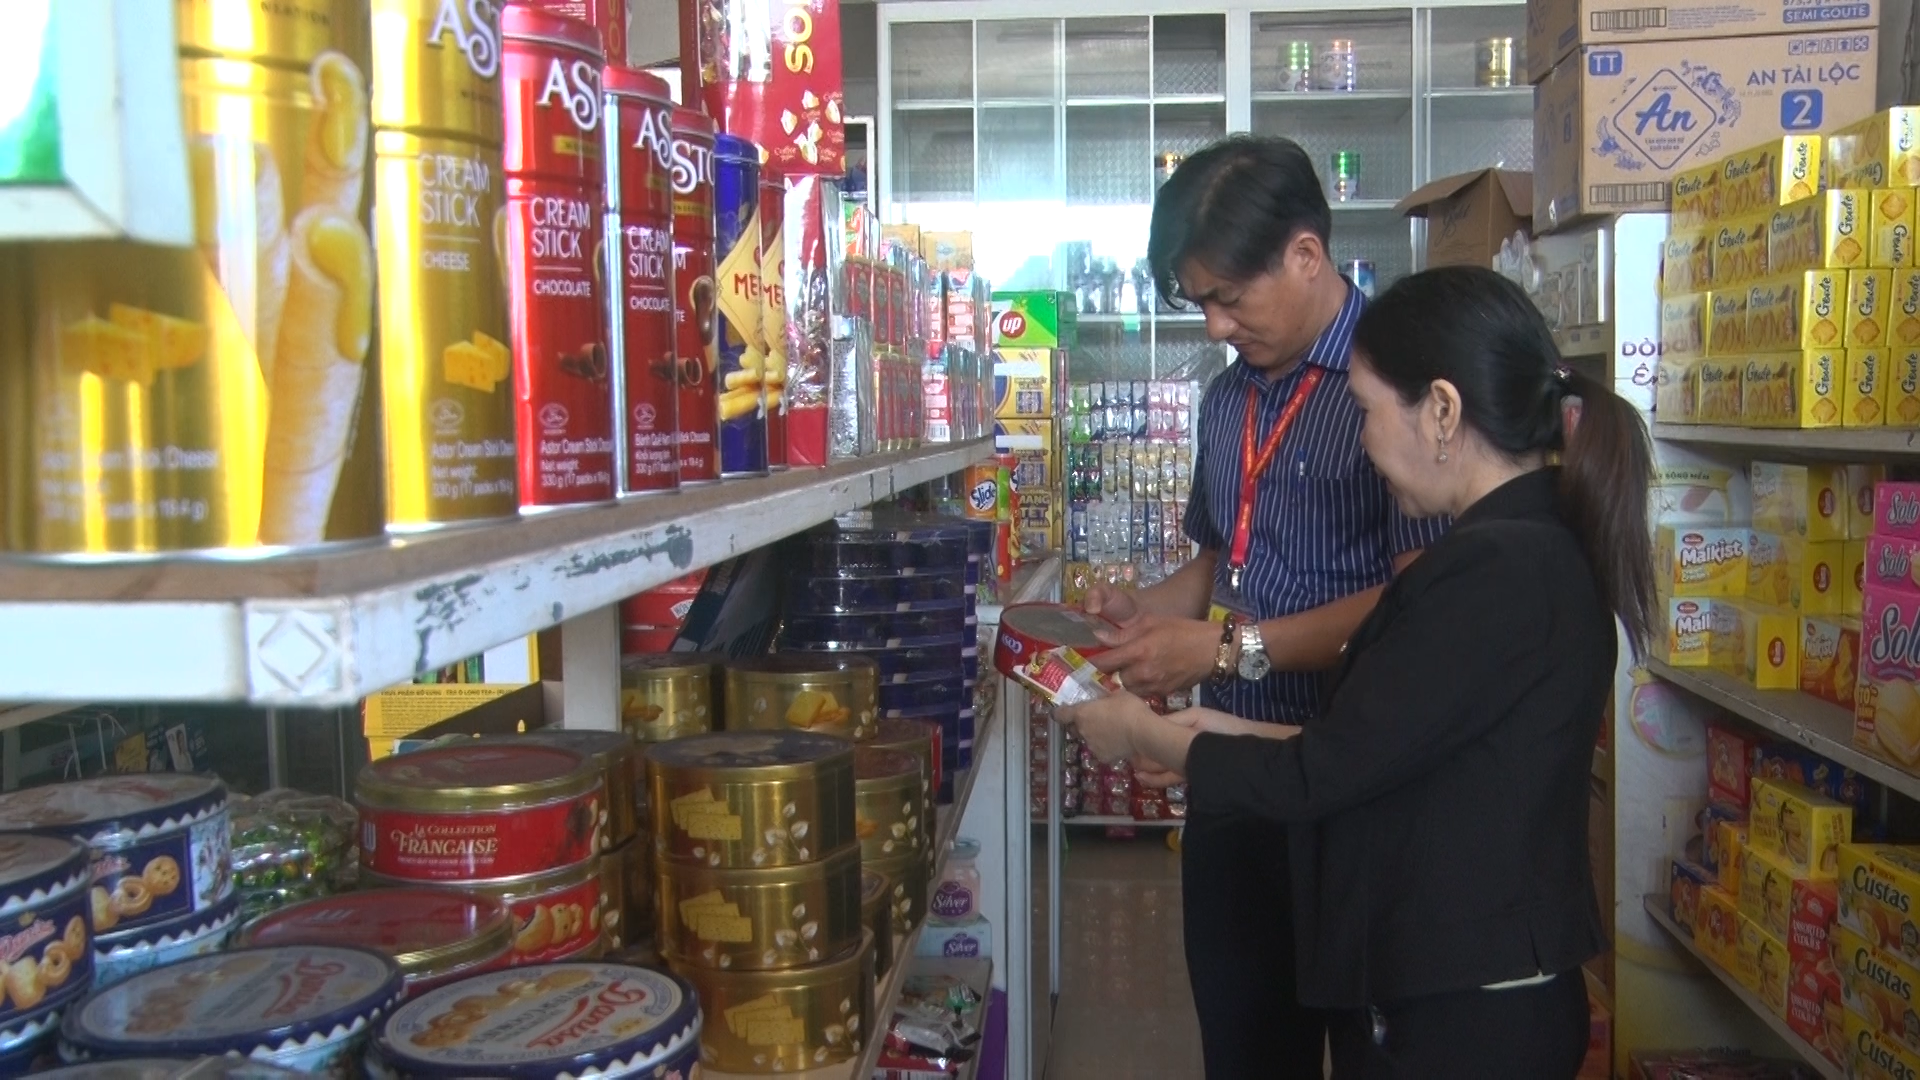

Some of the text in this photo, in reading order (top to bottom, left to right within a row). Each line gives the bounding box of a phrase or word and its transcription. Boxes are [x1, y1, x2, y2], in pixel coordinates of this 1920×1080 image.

[1786, 10, 1817, 22] SEMI
[1593, 54, 1618, 72] TT
[1747, 62, 1860, 86] AN TÀI LỘC
[1635, 93, 1697, 135] An
[1792, 95, 1812, 126] 2
[418, 154, 490, 192] CREAM
[421, 190, 480, 227] STICK
[530, 197, 591, 230] CREAM
[531, 229, 583, 259] STICK
[627, 225, 670, 254] CREAM
[423, 250, 470, 271] CHEESE
[629, 252, 665, 278] STICK
[533, 278, 592, 298] CHOCOLATE
[1681, 539, 1743, 567] Malkist
[932, 895, 968, 909] Silver
[1853, 865, 1910, 914] Custas
[1854, 948, 1911, 1000] Custas
